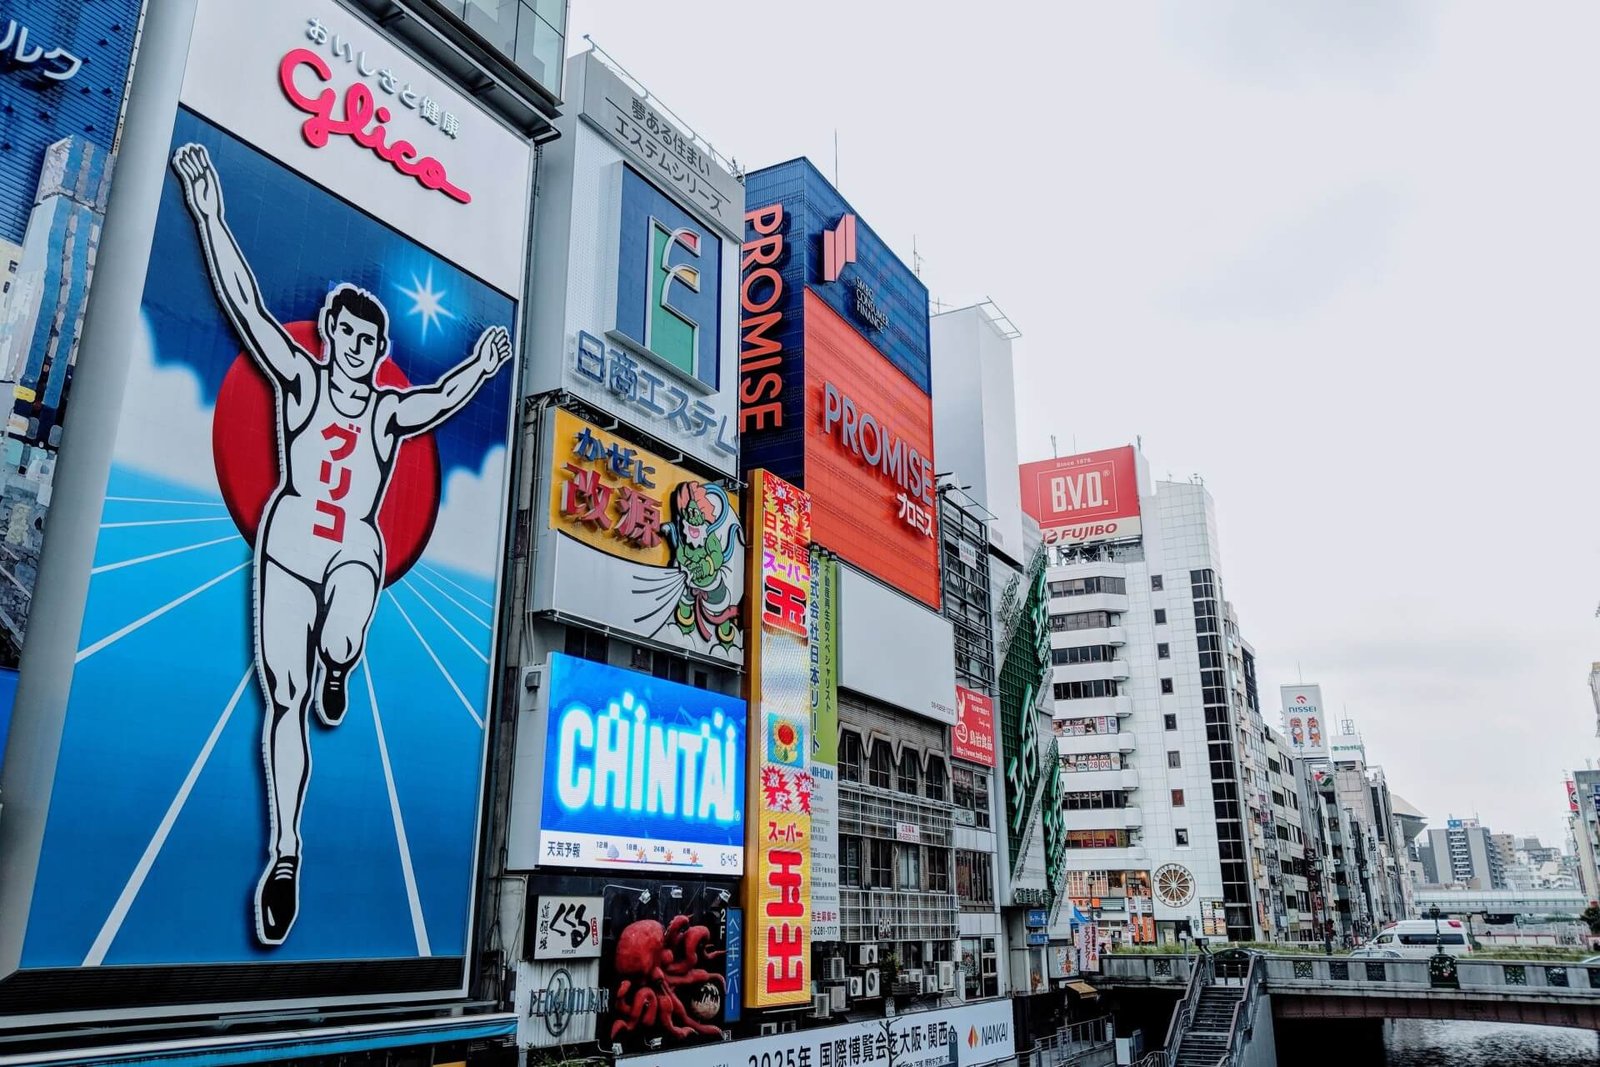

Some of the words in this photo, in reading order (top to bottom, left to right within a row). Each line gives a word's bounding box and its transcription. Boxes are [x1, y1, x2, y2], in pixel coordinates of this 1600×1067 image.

[306, 18, 459, 139] おいしさと健康
[632, 97, 710, 176] 夢ある住まい
[616, 116, 721, 217] エステムシリーズ
[856, 275, 874, 301] SMBC
[856, 289, 890, 328] CONSUMER
[739, 203, 783, 433] PROMISE
[856, 300, 885, 334] FINANCE
[823, 380, 934, 507] PROMISE
[313, 422, 362, 544] グリコ
[560, 462, 663, 548] 改源
[1051, 471, 1109, 513] B.V.D.
[895, 492, 934, 539] プロミス
[1061, 523, 1117, 541] FUJIBO
[763, 551, 811, 582] スーパー
[547, 841, 580, 858] 天気予報
[768, 821, 805, 843] スーパー
[549, 903, 590, 949] くくる
[766, 850, 805, 993] 玉出
[810, 926, 837, 936] -6281-1717
[727, 918, 740, 1010] ペンギンバー
[981, 1022, 1008, 1047] NANKAI
